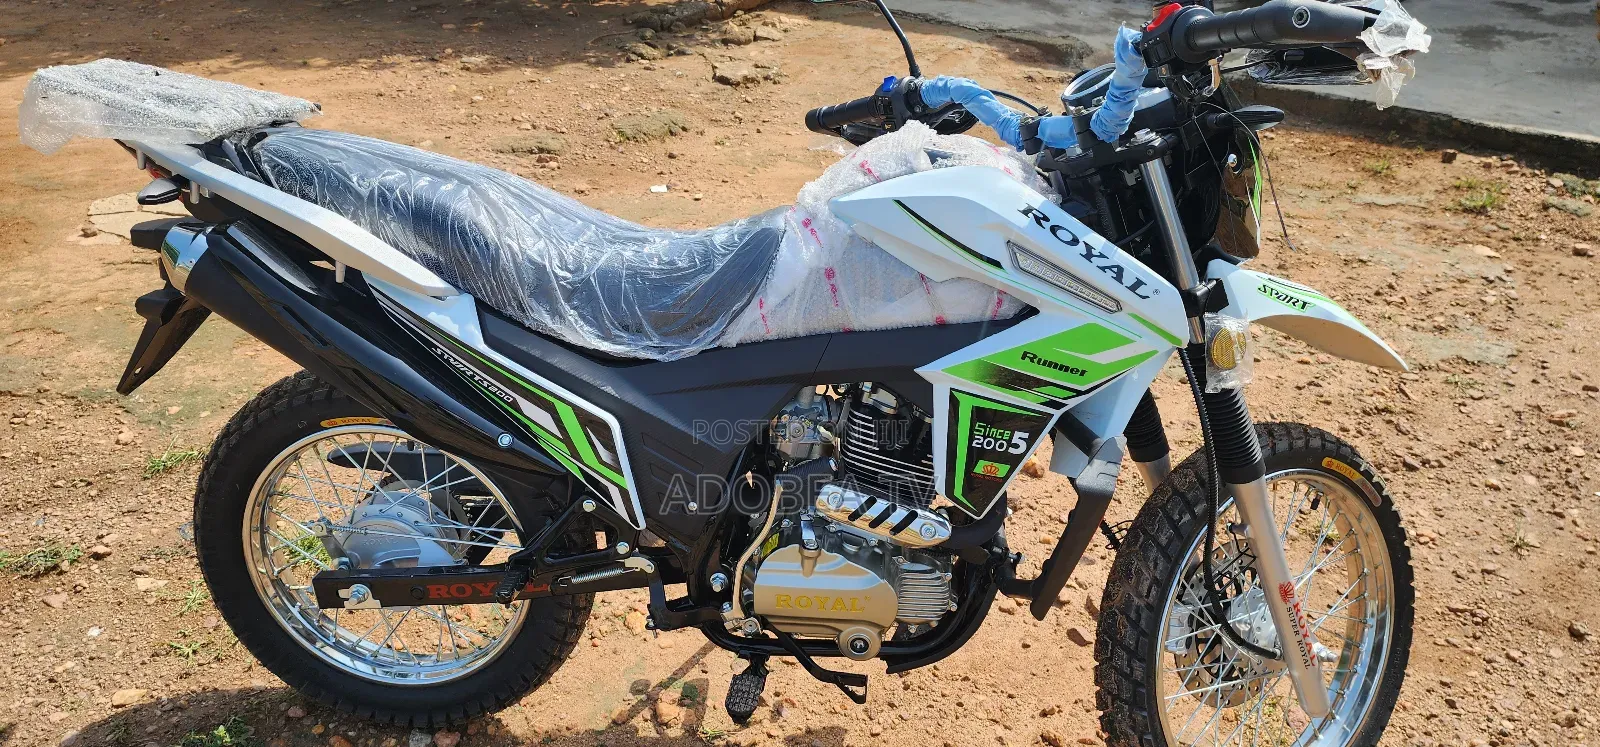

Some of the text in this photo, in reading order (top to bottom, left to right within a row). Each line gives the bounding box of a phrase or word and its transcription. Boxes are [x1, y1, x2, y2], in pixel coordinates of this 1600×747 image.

[1257, 284, 1310, 310] SPORT
[1020, 350, 1088, 376] Runner
[971, 430, 1030, 455] 2005
[973, 422, 1012, 440] Since
[426, 581, 548, 599] ROYL
[1286, 606, 1311, 670] SUPER ROYAL
[1292, 602, 1316, 667] ROYAL
